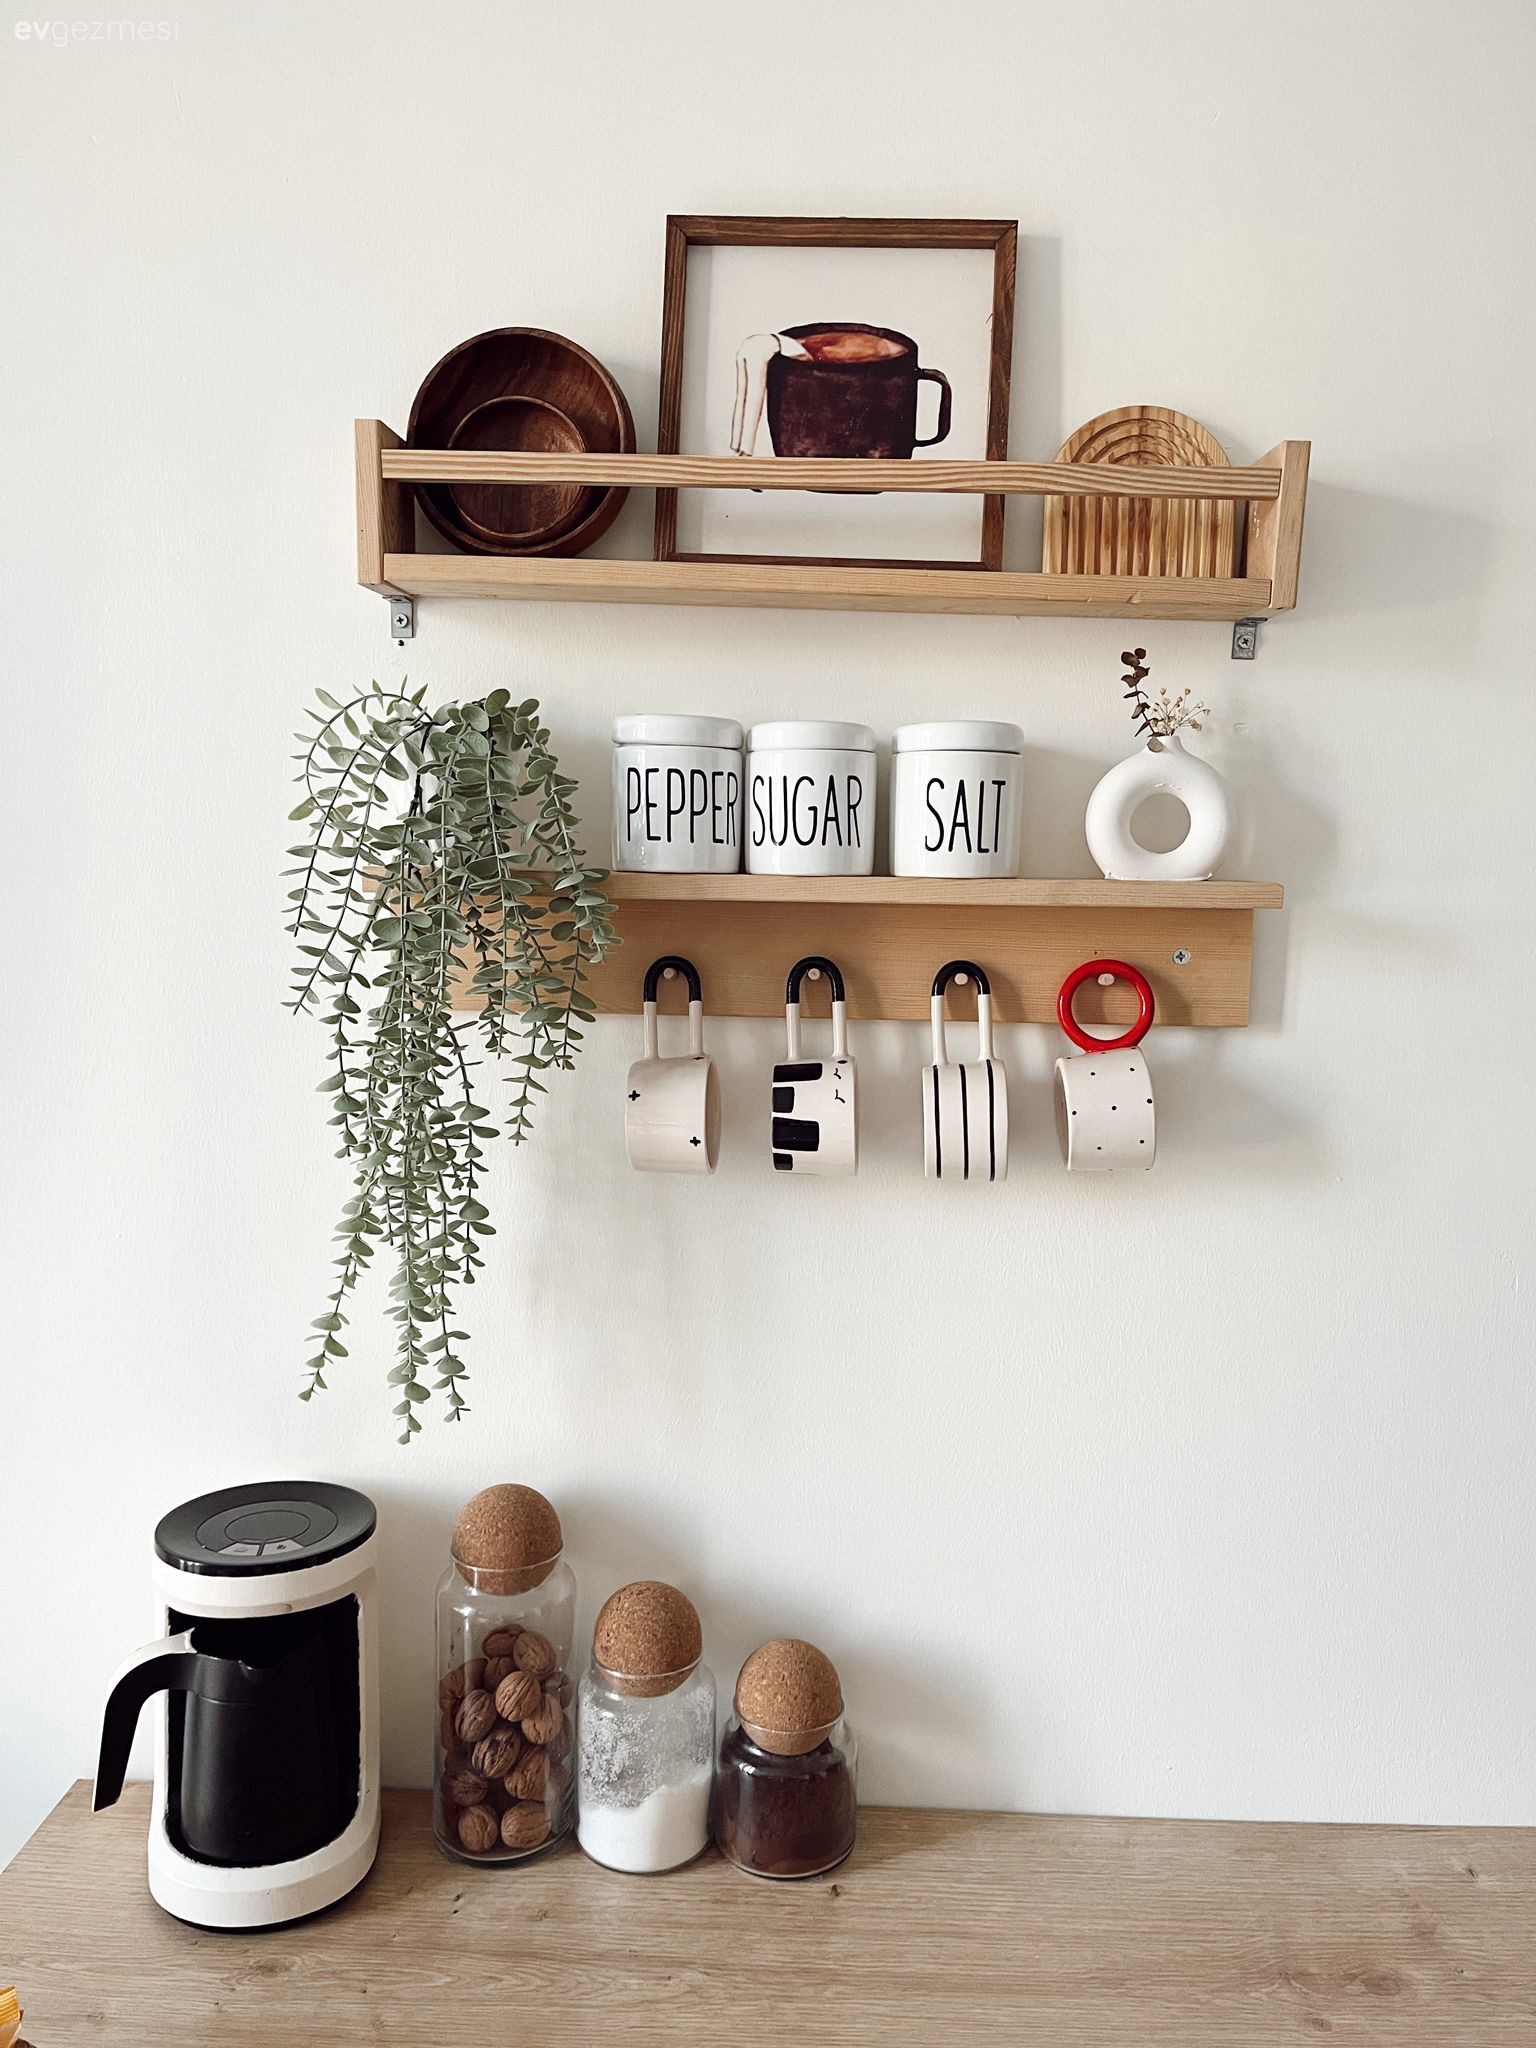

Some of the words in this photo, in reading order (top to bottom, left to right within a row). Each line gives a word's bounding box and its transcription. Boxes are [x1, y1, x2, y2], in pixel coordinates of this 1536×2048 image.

[627, 767, 738, 847] PEPPER
[752, 775, 862, 848] SUGAR
[925, 777, 1006, 854] SALT
